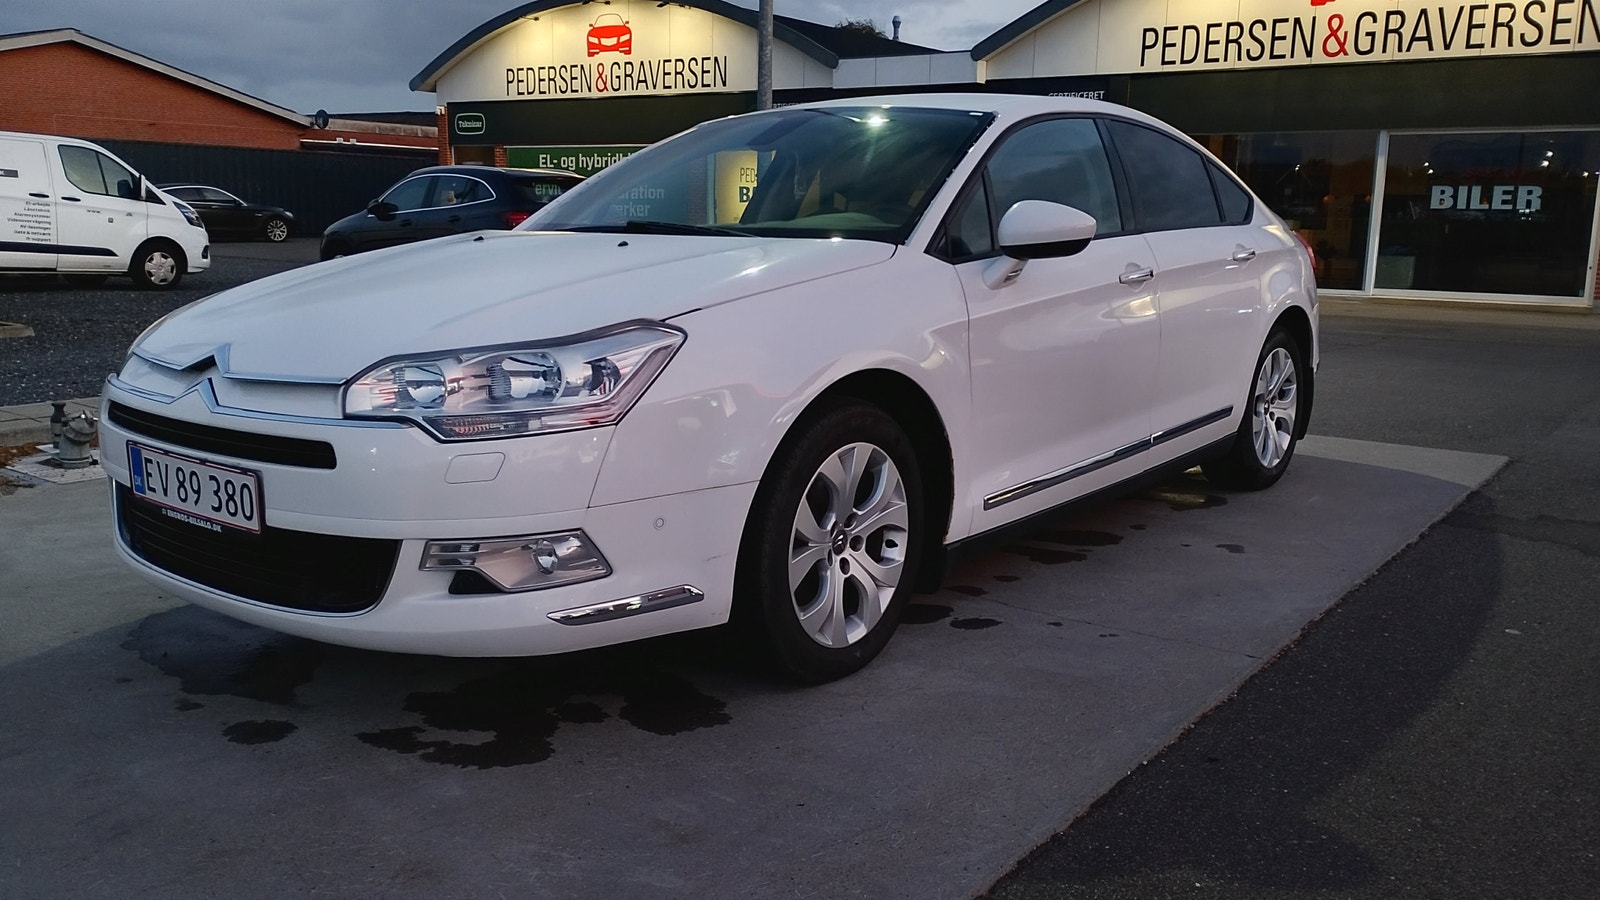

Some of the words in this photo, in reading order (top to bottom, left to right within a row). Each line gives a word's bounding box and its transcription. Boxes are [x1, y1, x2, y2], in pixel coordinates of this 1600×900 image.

[539, 154, 557, 168] EL-
[561, 157, 576, 170] og
[1429, 185, 1543, 211] BILER
[144, 456, 169, 497] EV
[176, 466, 201, 507] 89
[208, 474, 254, 522] 380
